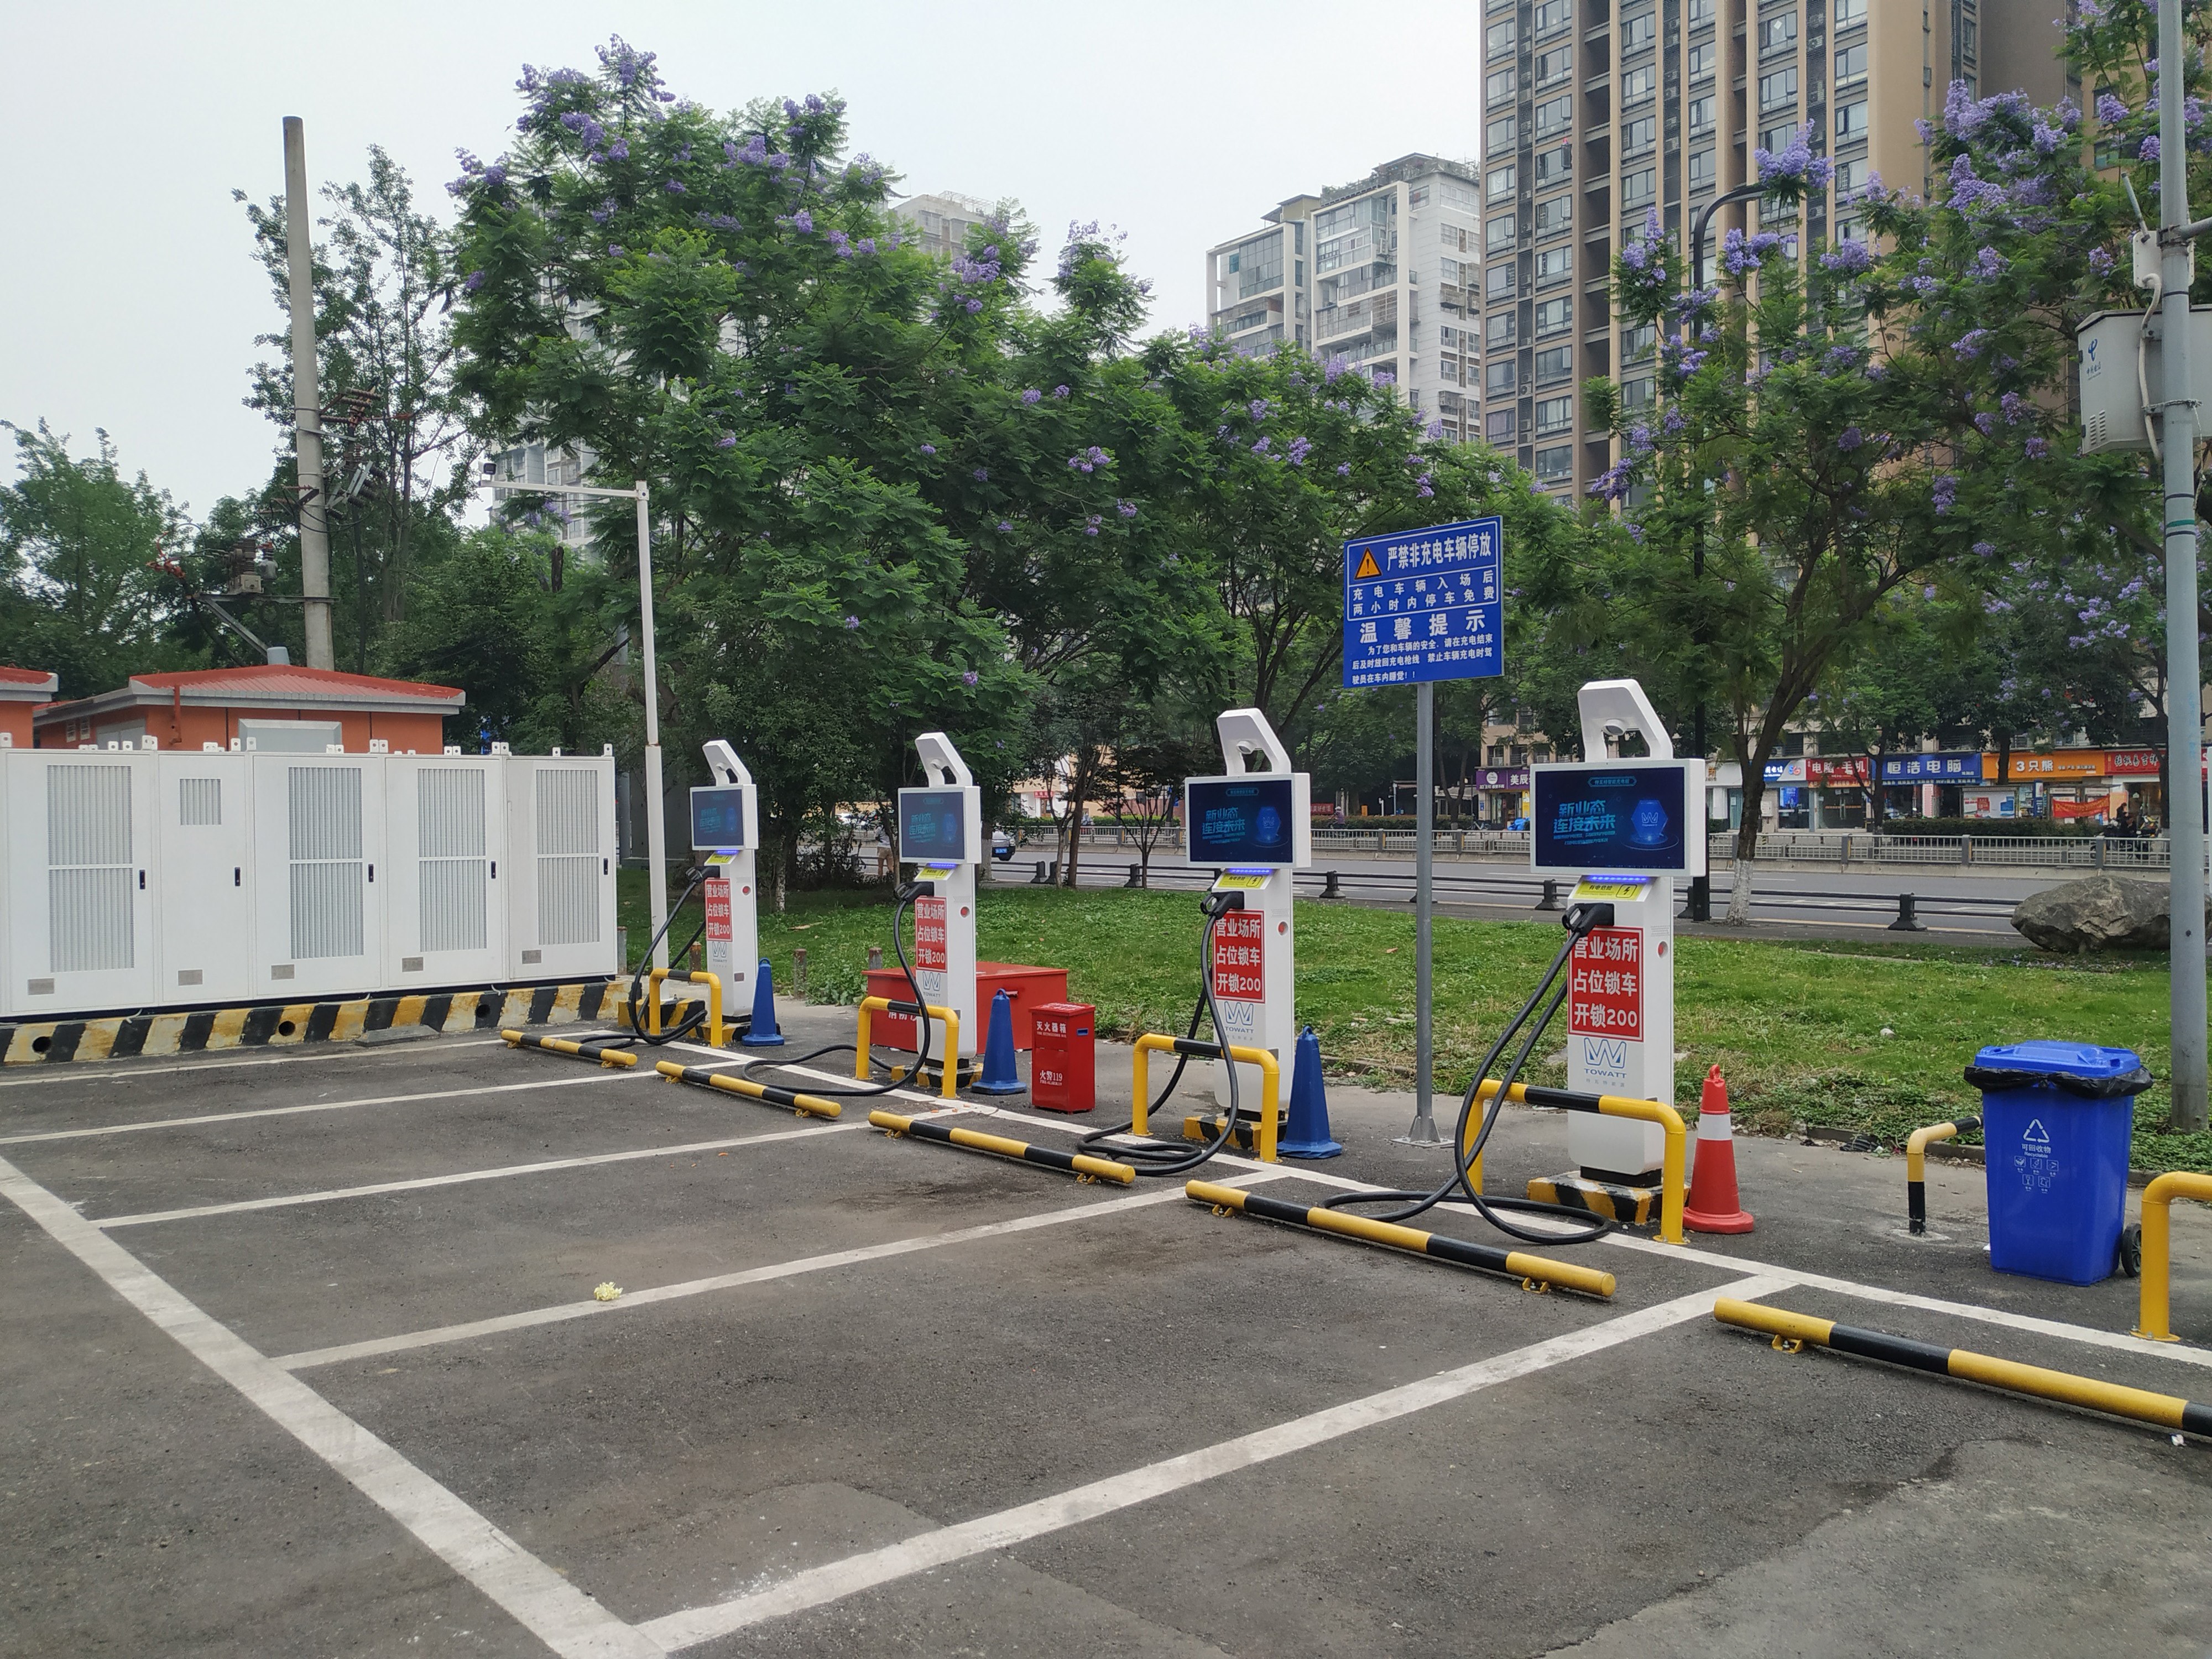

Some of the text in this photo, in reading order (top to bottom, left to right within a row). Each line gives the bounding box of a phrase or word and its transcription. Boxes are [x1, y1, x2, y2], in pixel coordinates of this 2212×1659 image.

[1387, 531, 1491, 571] 严禁非充电车辆停放
[1353, 570, 1494, 601] 充电车辆入场后
[1353, 586, 1495, 617] 两小时内停车免费
[1359, 609, 1486, 644] 温馨提示
[1427, 647, 1493, 663] 禁止车辆充电时驾
[1887, 759, 1961, 774] 恒浩电脑
[2016, 760, 2053, 772] 3只熊
[1510, 774, 1531, 785] 美辰
[1206, 807, 1238, 822] 新业态
[1559, 800, 1606, 818] 新业态
[1553, 814, 1616, 833] 连接未来
[917, 902, 945, 921] 营业场所
[917, 925, 945, 943] 占位锁车
[1216, 917, 1261, 939] 营业场所
[918, 948, 945, 964] 开锁200
[1217, 945, 1261, 967] 占位锁车
[1574, 936, 1639, 963] 营业场所
[1217, 973, 1261, 993] 开锁200
[1574, 968, 1637, 997] 占位锁车
[1574, 1003, 1638, 1029] 开锁200
[1036, 1021, 1066, 1034] 灭火器箱
[1584, 1068, 1627, 1078] TOWATT
[2022, 1144, 2051, 1154] 可回收物
